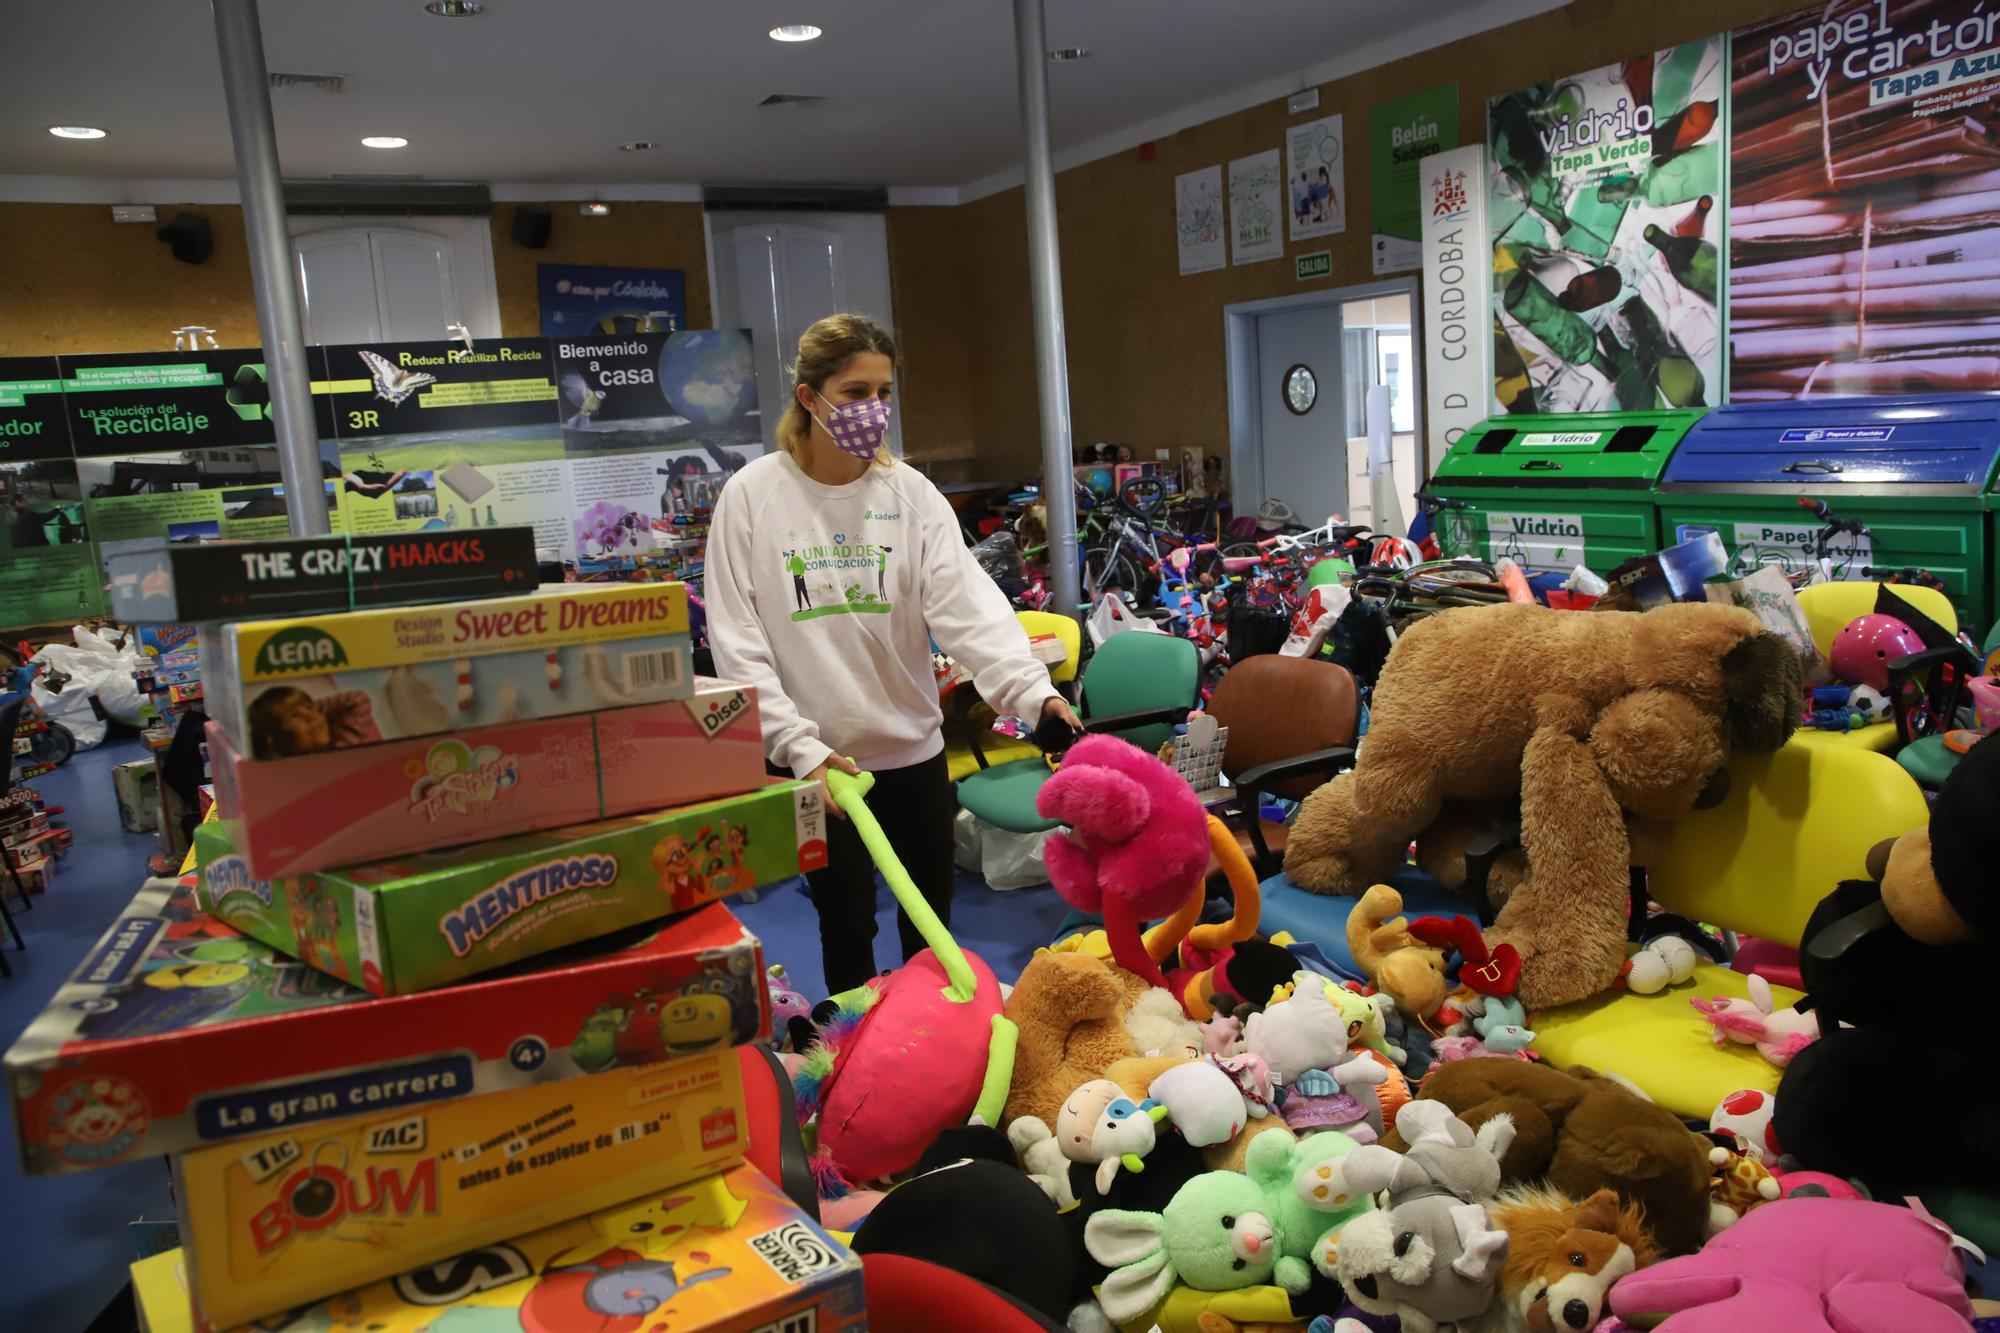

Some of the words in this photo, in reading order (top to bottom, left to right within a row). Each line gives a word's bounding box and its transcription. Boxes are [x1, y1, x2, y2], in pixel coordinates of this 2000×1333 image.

[1769, 0, 1893, 76] papel
[1806, 57, 1831, 100] y
[1871, 69, 1939, 99] Tapa
[1392, 118, 1439, 148] Belén
[1540, 98, 1655, 154] vidrio
[1392, 141, 1441, 164] Sadeco
[1553, 151, 1594, 173] Tapa
[1599, 137, 1651, 163] Verde
[1299, 256, 1329, 275] SALIDA
[1439, 228, 1467, 361] CORDOBA
[400, 352, 445, 367] Reduce
[500, 347, 542, 361] Recicla
[560, 341, 648, 358] Bienvenido
[590, 361, 600, 371] a
[600, 367, 654, 386] casa
[169, 372, 216, 385] recuperan
[80, 408, 97, 419] La
[101, 403, 154, 418] solución
[157, 404, 177, 415] del
[349, 411, 379, 428] 3R
[94, 412, 209, 436] Reciclaje
[1826, 431, 1849, 439] Papel
[1552, 434, 1593, 444] Vidrio
[1511, 517, 1580, 537] Vidrio
[1762, 528, 1814, 545] Papel
[242, 551, 296, 582] THE
[301, 546, 384, 579] CRAZY
[387, 539, 486, 568] HAACKS
[856, 544, 874, 556] DE
[1802, 543, 1869, 558] Crtón
[393, 616, 443, 635] Design
[453, 603, 549, 643] Sweet
[558, 594, 670, 630] Dreams
[268, 637, 334, 666] LENA
[703, 691, 746, 731] Diset
[12, 789, 33, 805] 500
[444, 857, 616, 953] MENTIROSO
[1476, 959, 1499, 982] U
[518, 1048, 542, 1063] 4+
[218, 1105, 258, 1129] La
[268, 1089, 338, 1125] gran
[349, 1070, 458, 1106] carrera
[368, 1121, 420, 1148] TAC
[254, 1141, 296, 1174] TIC
[458, 1167, 502, 1190] antes
[506, 1160, 525, 1176] de
[529, 1140, 591, 1169] explotar
[595, 1134, 613, 1150] de
[620, 1124, 635, 1141] RI
[248, 1155, 441, 1254] BOUM
[752, 1231, 812, 1282] PARKER
